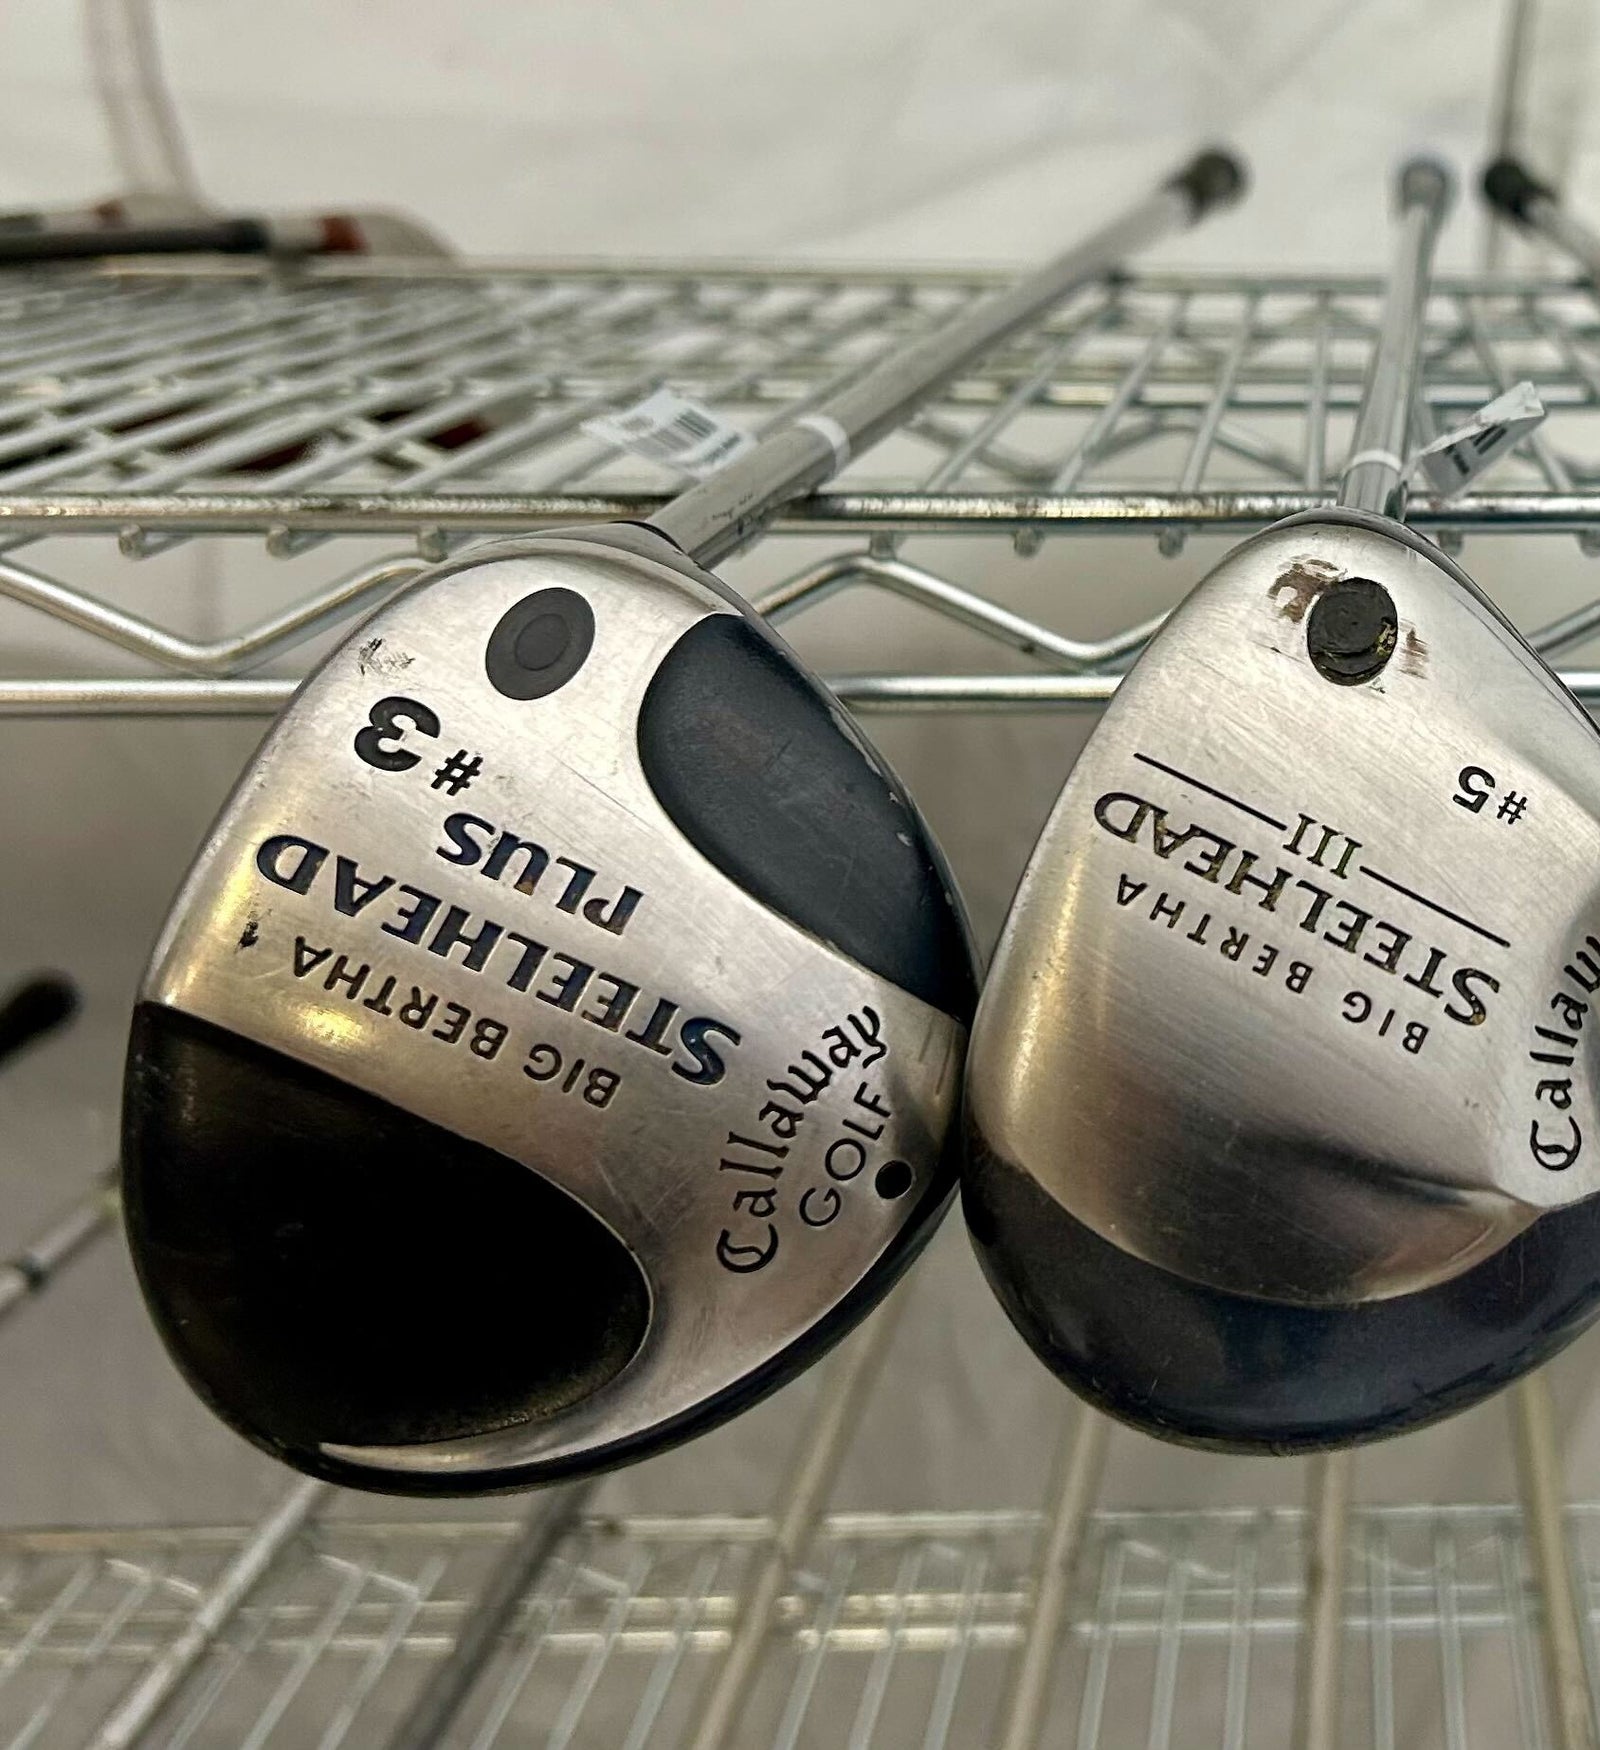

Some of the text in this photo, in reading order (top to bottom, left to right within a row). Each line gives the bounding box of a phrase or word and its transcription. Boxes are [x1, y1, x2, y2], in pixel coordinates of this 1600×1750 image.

[435, 812, 645, 936] PLUS
[1094, 790, 1501, 1027] STEELHEAD
[1282, 812, 1364, 881] III
[255, 833, 742, 1086] STEELHEAD
[291, 936, 622, 1109] BIG BERTHA
[1116, 872, 1429, 1055] BIG BERTHA
[716, 1005, 888, 1274] Callaway
[799, 1084, 897, 1227] GOLF
